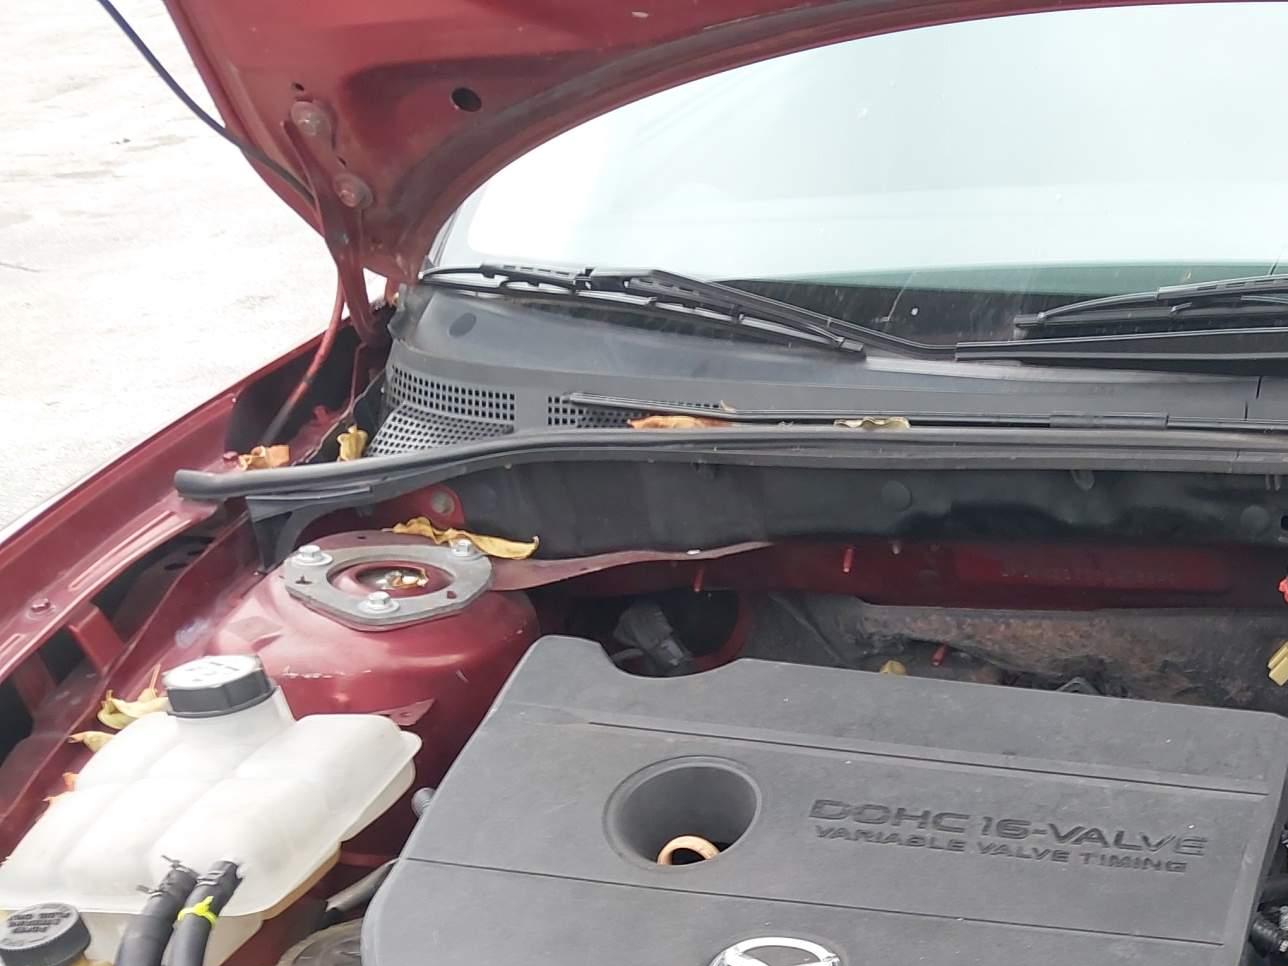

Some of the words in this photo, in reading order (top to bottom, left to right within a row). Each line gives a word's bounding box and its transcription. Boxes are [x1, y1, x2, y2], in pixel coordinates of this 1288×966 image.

[809, 799, 970, 834] DOHC
[980, 816, 1208, 857] 16-VALVE
[815, 825, 967, 852] VARIABLE
[977, 841, 1071, 863] VALVE
[1079, 852, 1188, 872] TIMING
